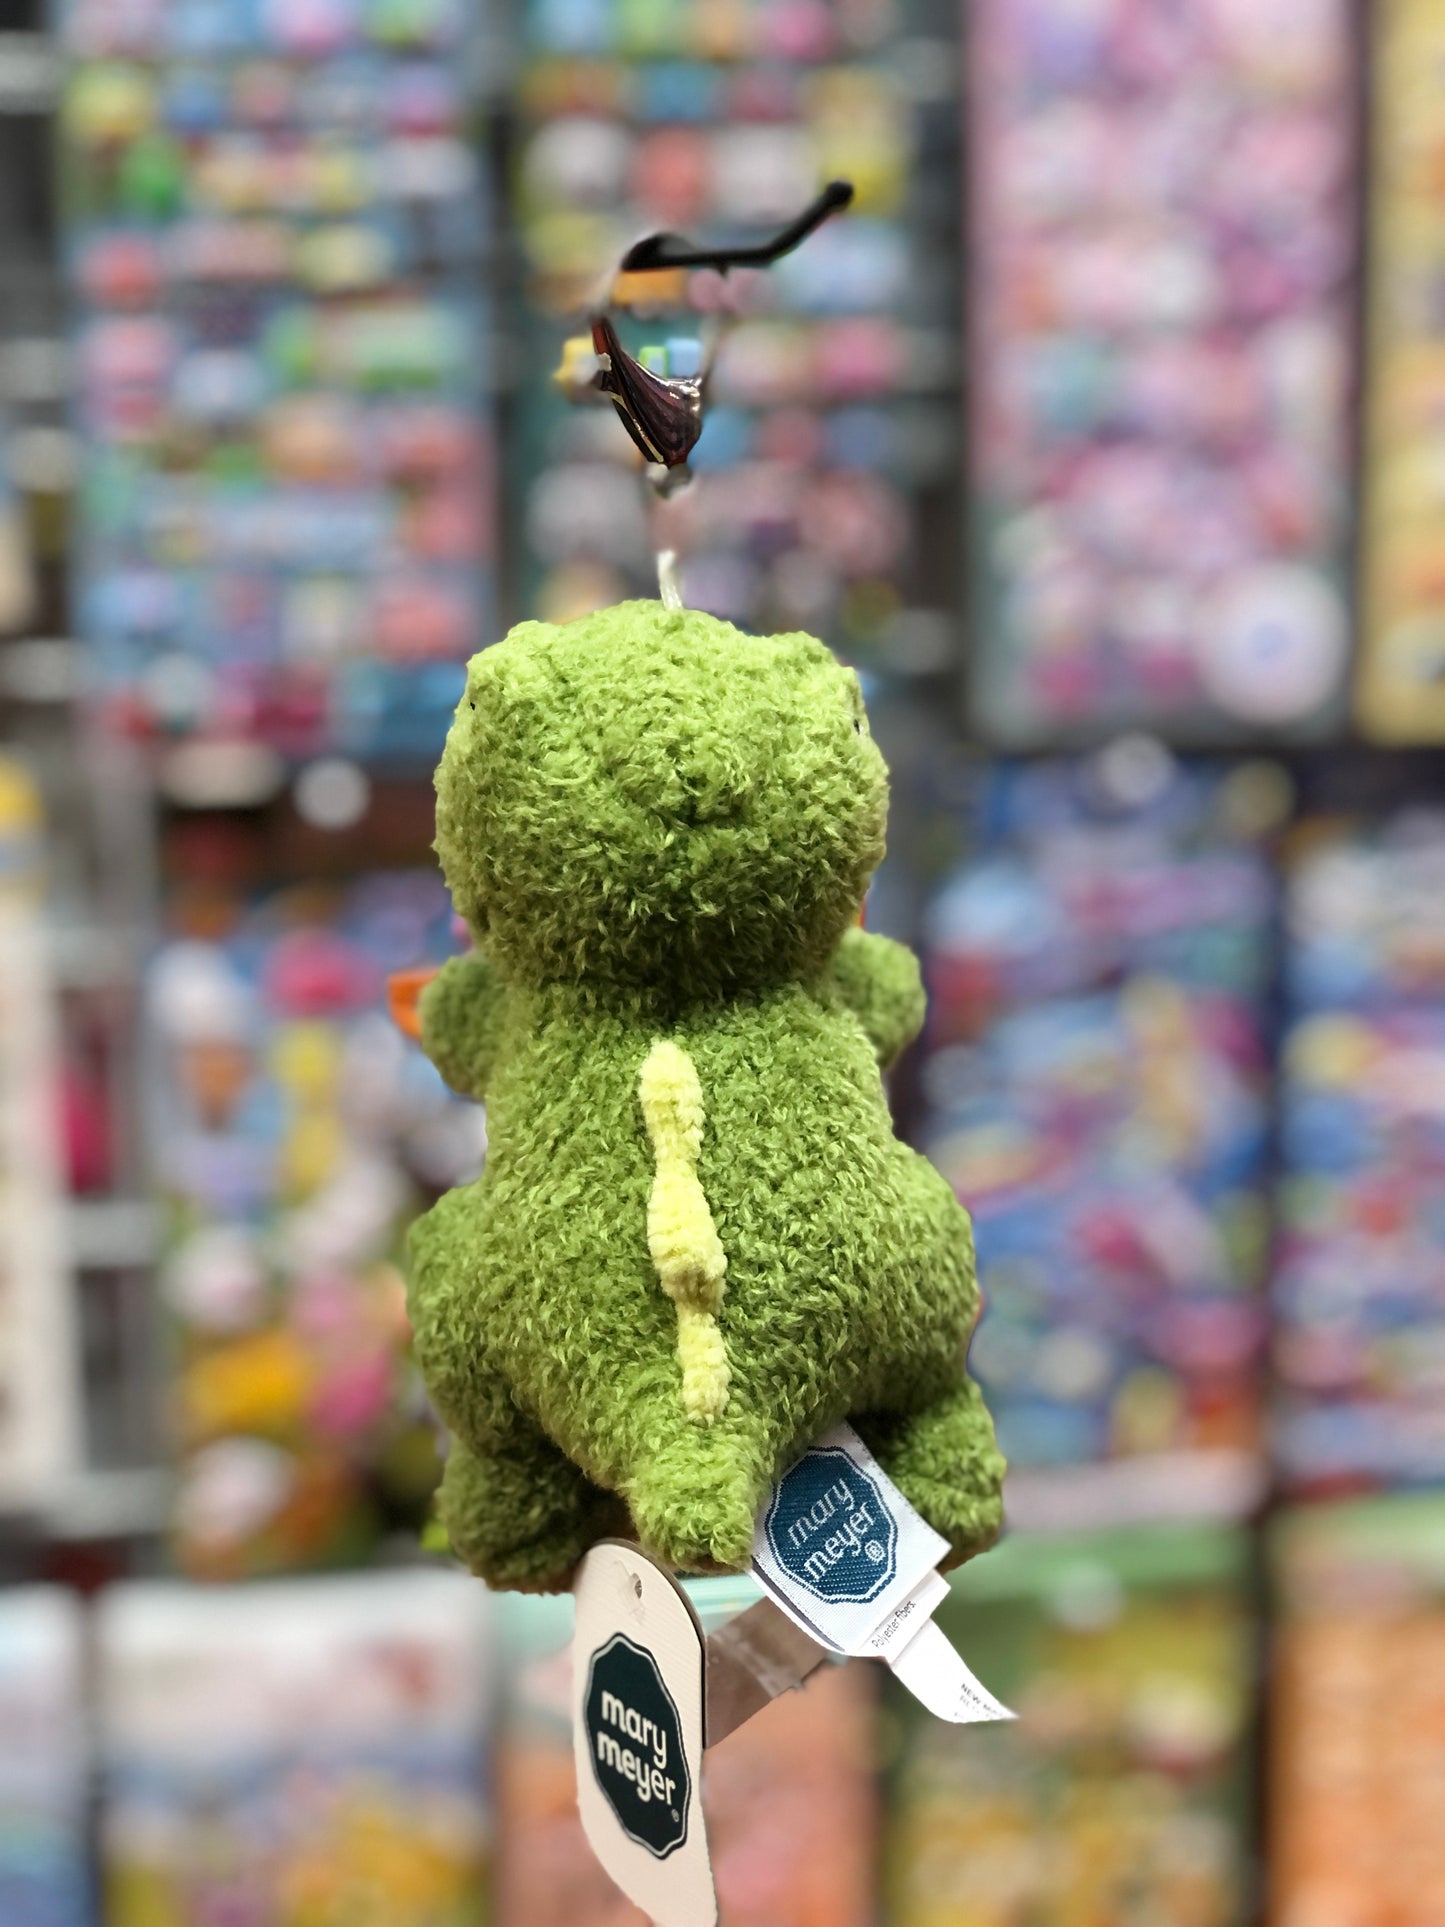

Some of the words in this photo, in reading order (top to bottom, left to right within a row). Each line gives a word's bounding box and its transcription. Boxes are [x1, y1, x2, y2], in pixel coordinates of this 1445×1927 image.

[787, 1478, 855, 1548] mary
[871, 1617, 901, 1648] Polyester
[601, 1690, 667, 1770] mary
